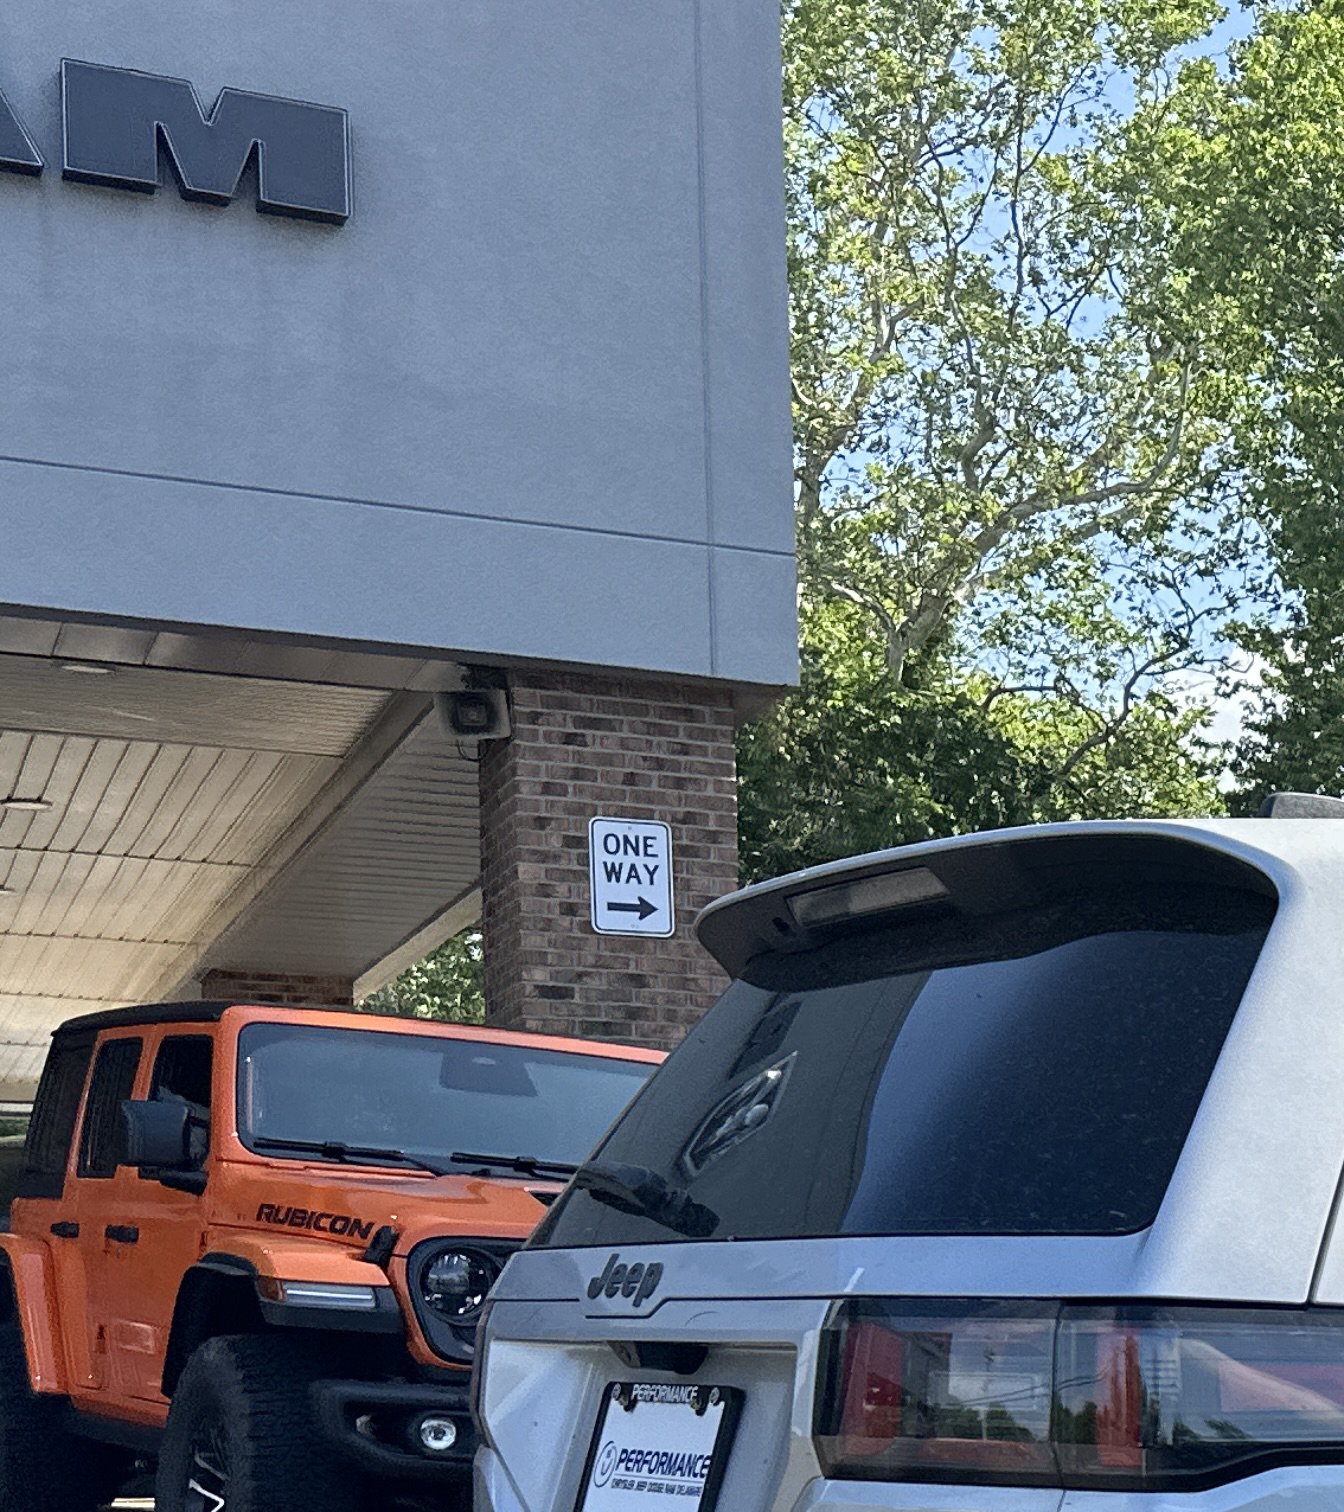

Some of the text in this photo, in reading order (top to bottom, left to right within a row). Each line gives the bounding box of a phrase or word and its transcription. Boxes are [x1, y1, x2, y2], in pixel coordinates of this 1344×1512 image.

[603, 833, 659, 858] ONE
[602, 861, 660, 886] WAY
[256, 1203, 375, 1239] RUBICON
[587, 1253, 665, 1308] Jeep
[630, 1384, 699, 1403] PERFORMANCE
[615, 1448, 712, 1478] PERFORMANCE
